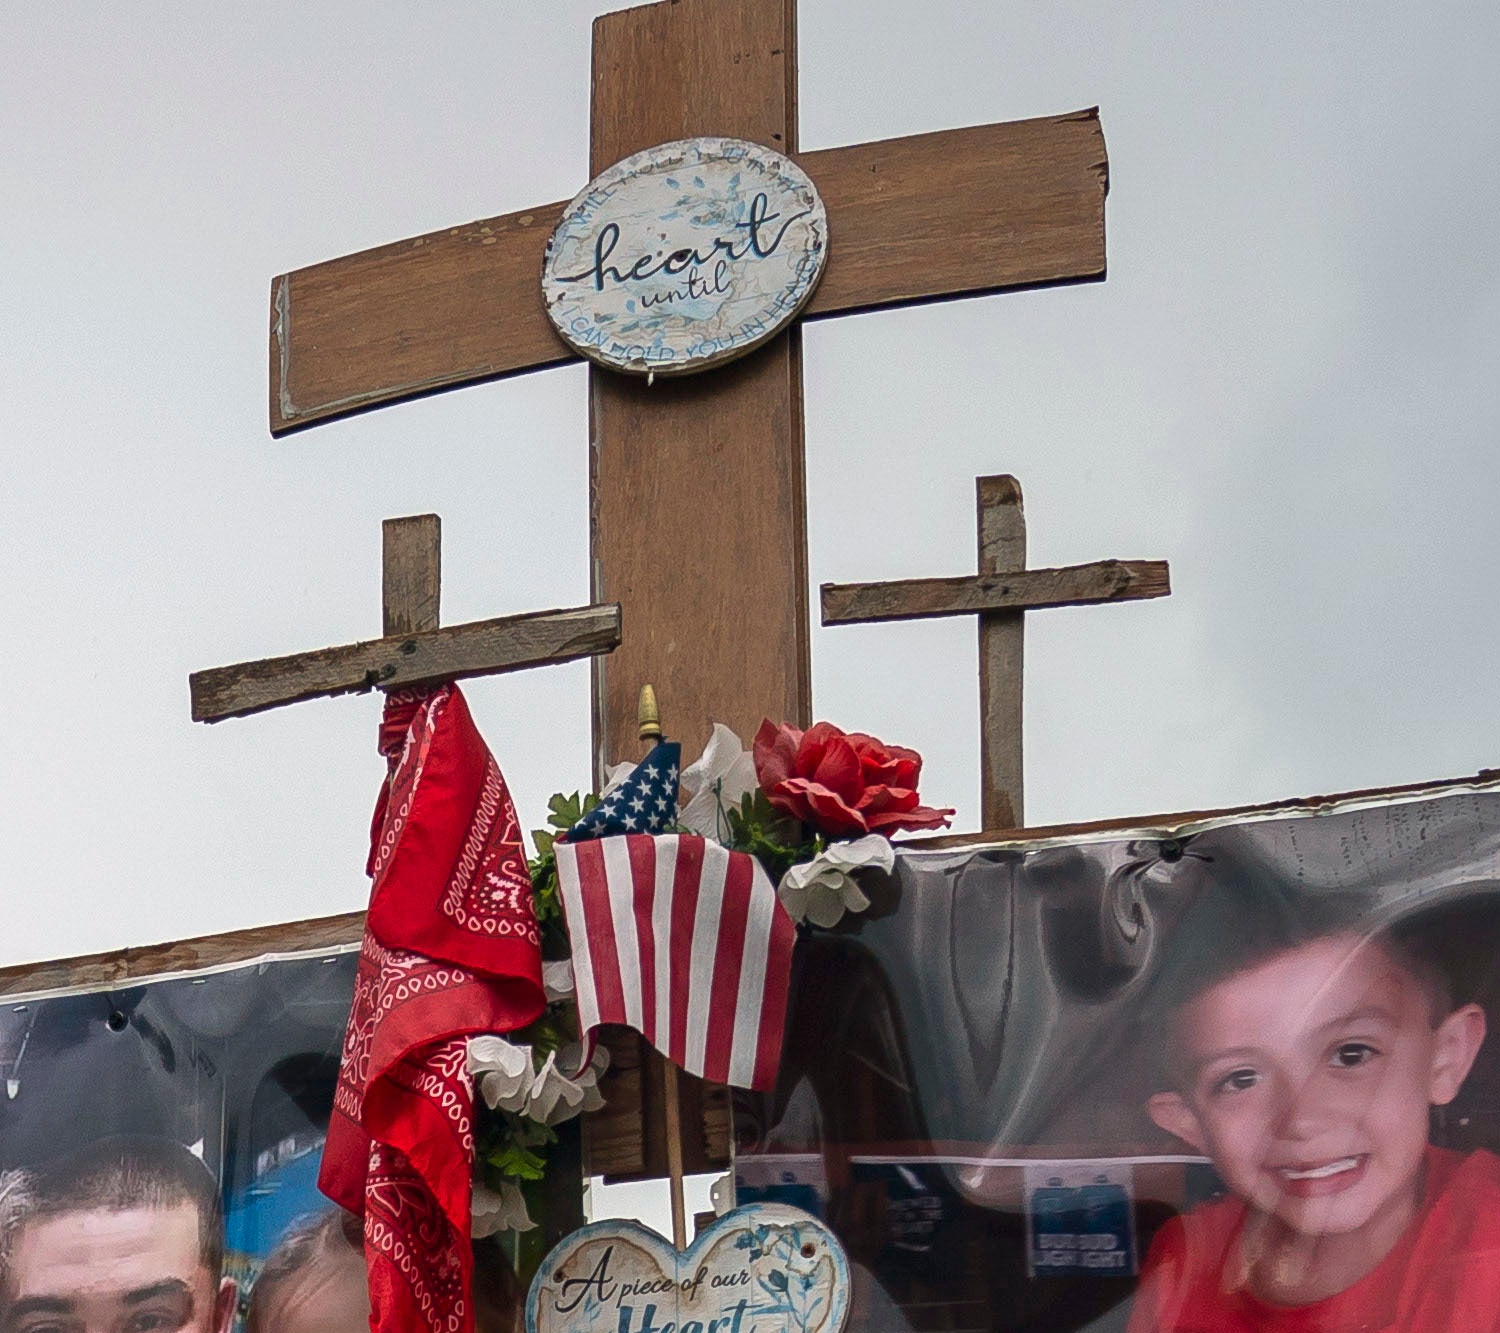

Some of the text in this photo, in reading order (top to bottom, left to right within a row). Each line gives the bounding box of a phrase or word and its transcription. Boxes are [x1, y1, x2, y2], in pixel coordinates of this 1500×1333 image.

[555, 192, 813, 291] heart
[642, 260, 731, 308] until
[570, 316, 610, 348] CAN
[609, 341, 676, 360] HOLD
[686, 334, 736, 357] YOU
[555, 1246, 752, 1313] A piece of our
